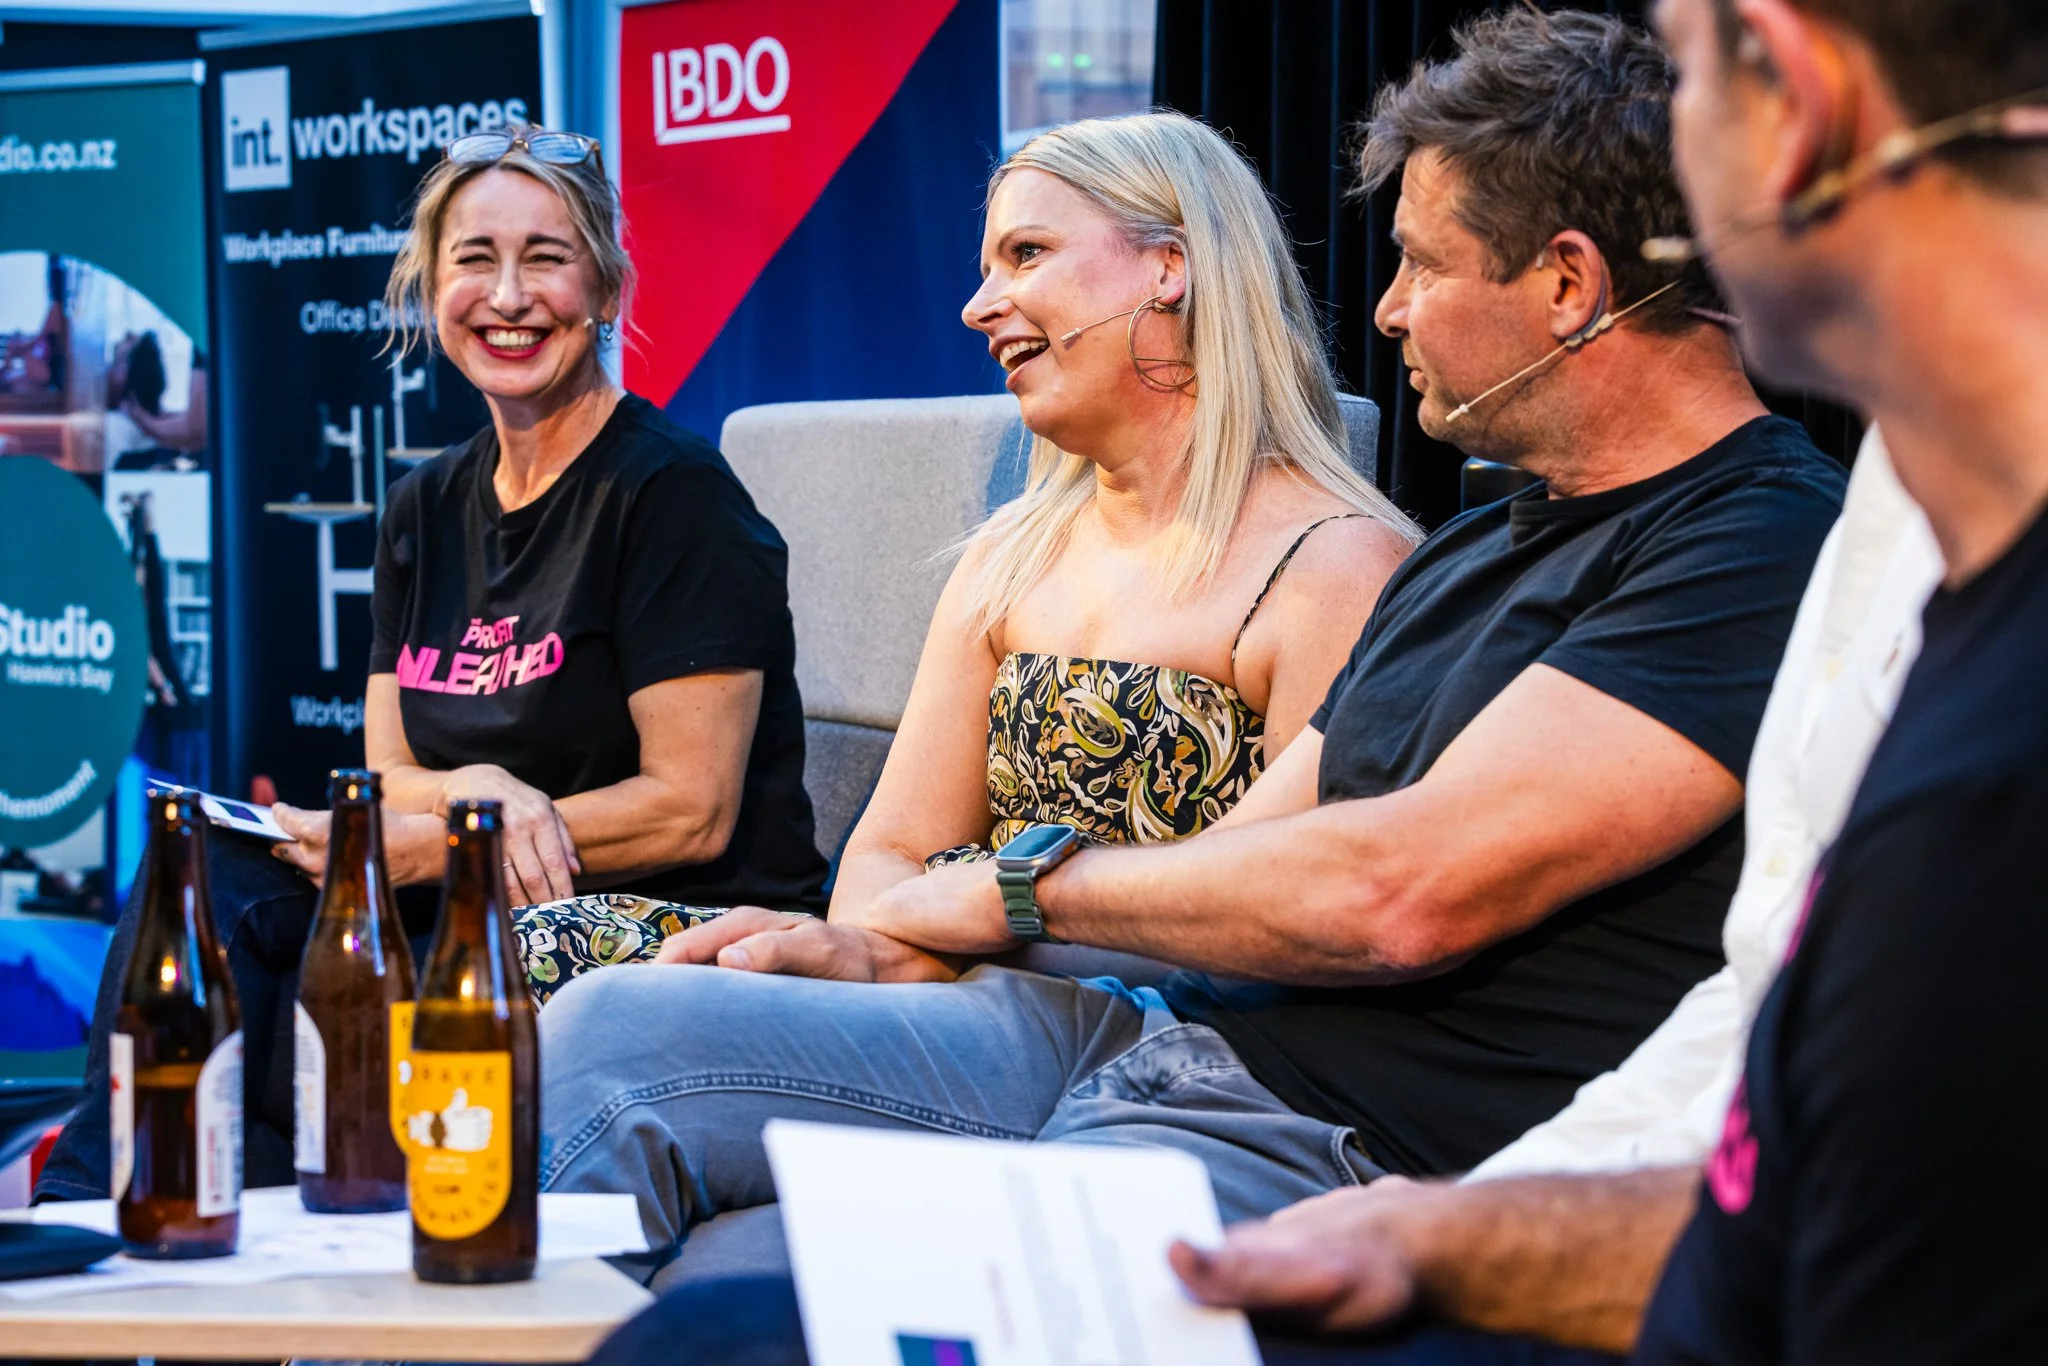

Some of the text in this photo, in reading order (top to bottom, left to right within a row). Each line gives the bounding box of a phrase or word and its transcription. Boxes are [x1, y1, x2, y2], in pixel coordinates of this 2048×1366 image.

[668, 36, 791, 122] BDO
[293, 97, 528, 164] workspaces
[222, 223, 411, 268] Workplace Furnitur
[301, 300, 366, 334] Office
[80, 662, 113, 694] Bay
